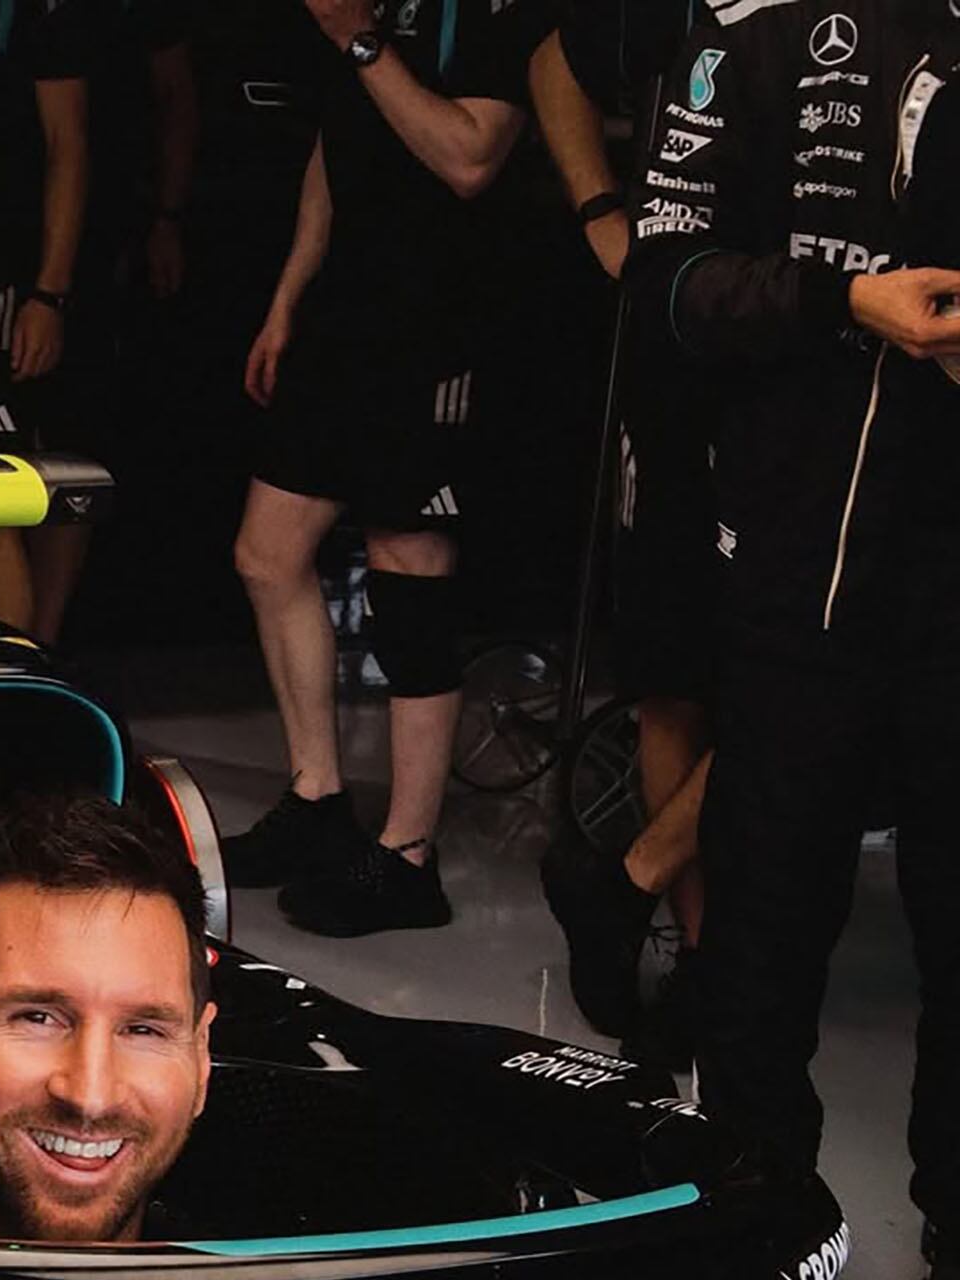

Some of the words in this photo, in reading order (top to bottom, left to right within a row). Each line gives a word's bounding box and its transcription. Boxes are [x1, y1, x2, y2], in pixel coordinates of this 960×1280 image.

[824, 101, 861, 127] JBS
[642, 197, 692, 218] AMD
[501, 1051, 625, 1089] BONVOY
